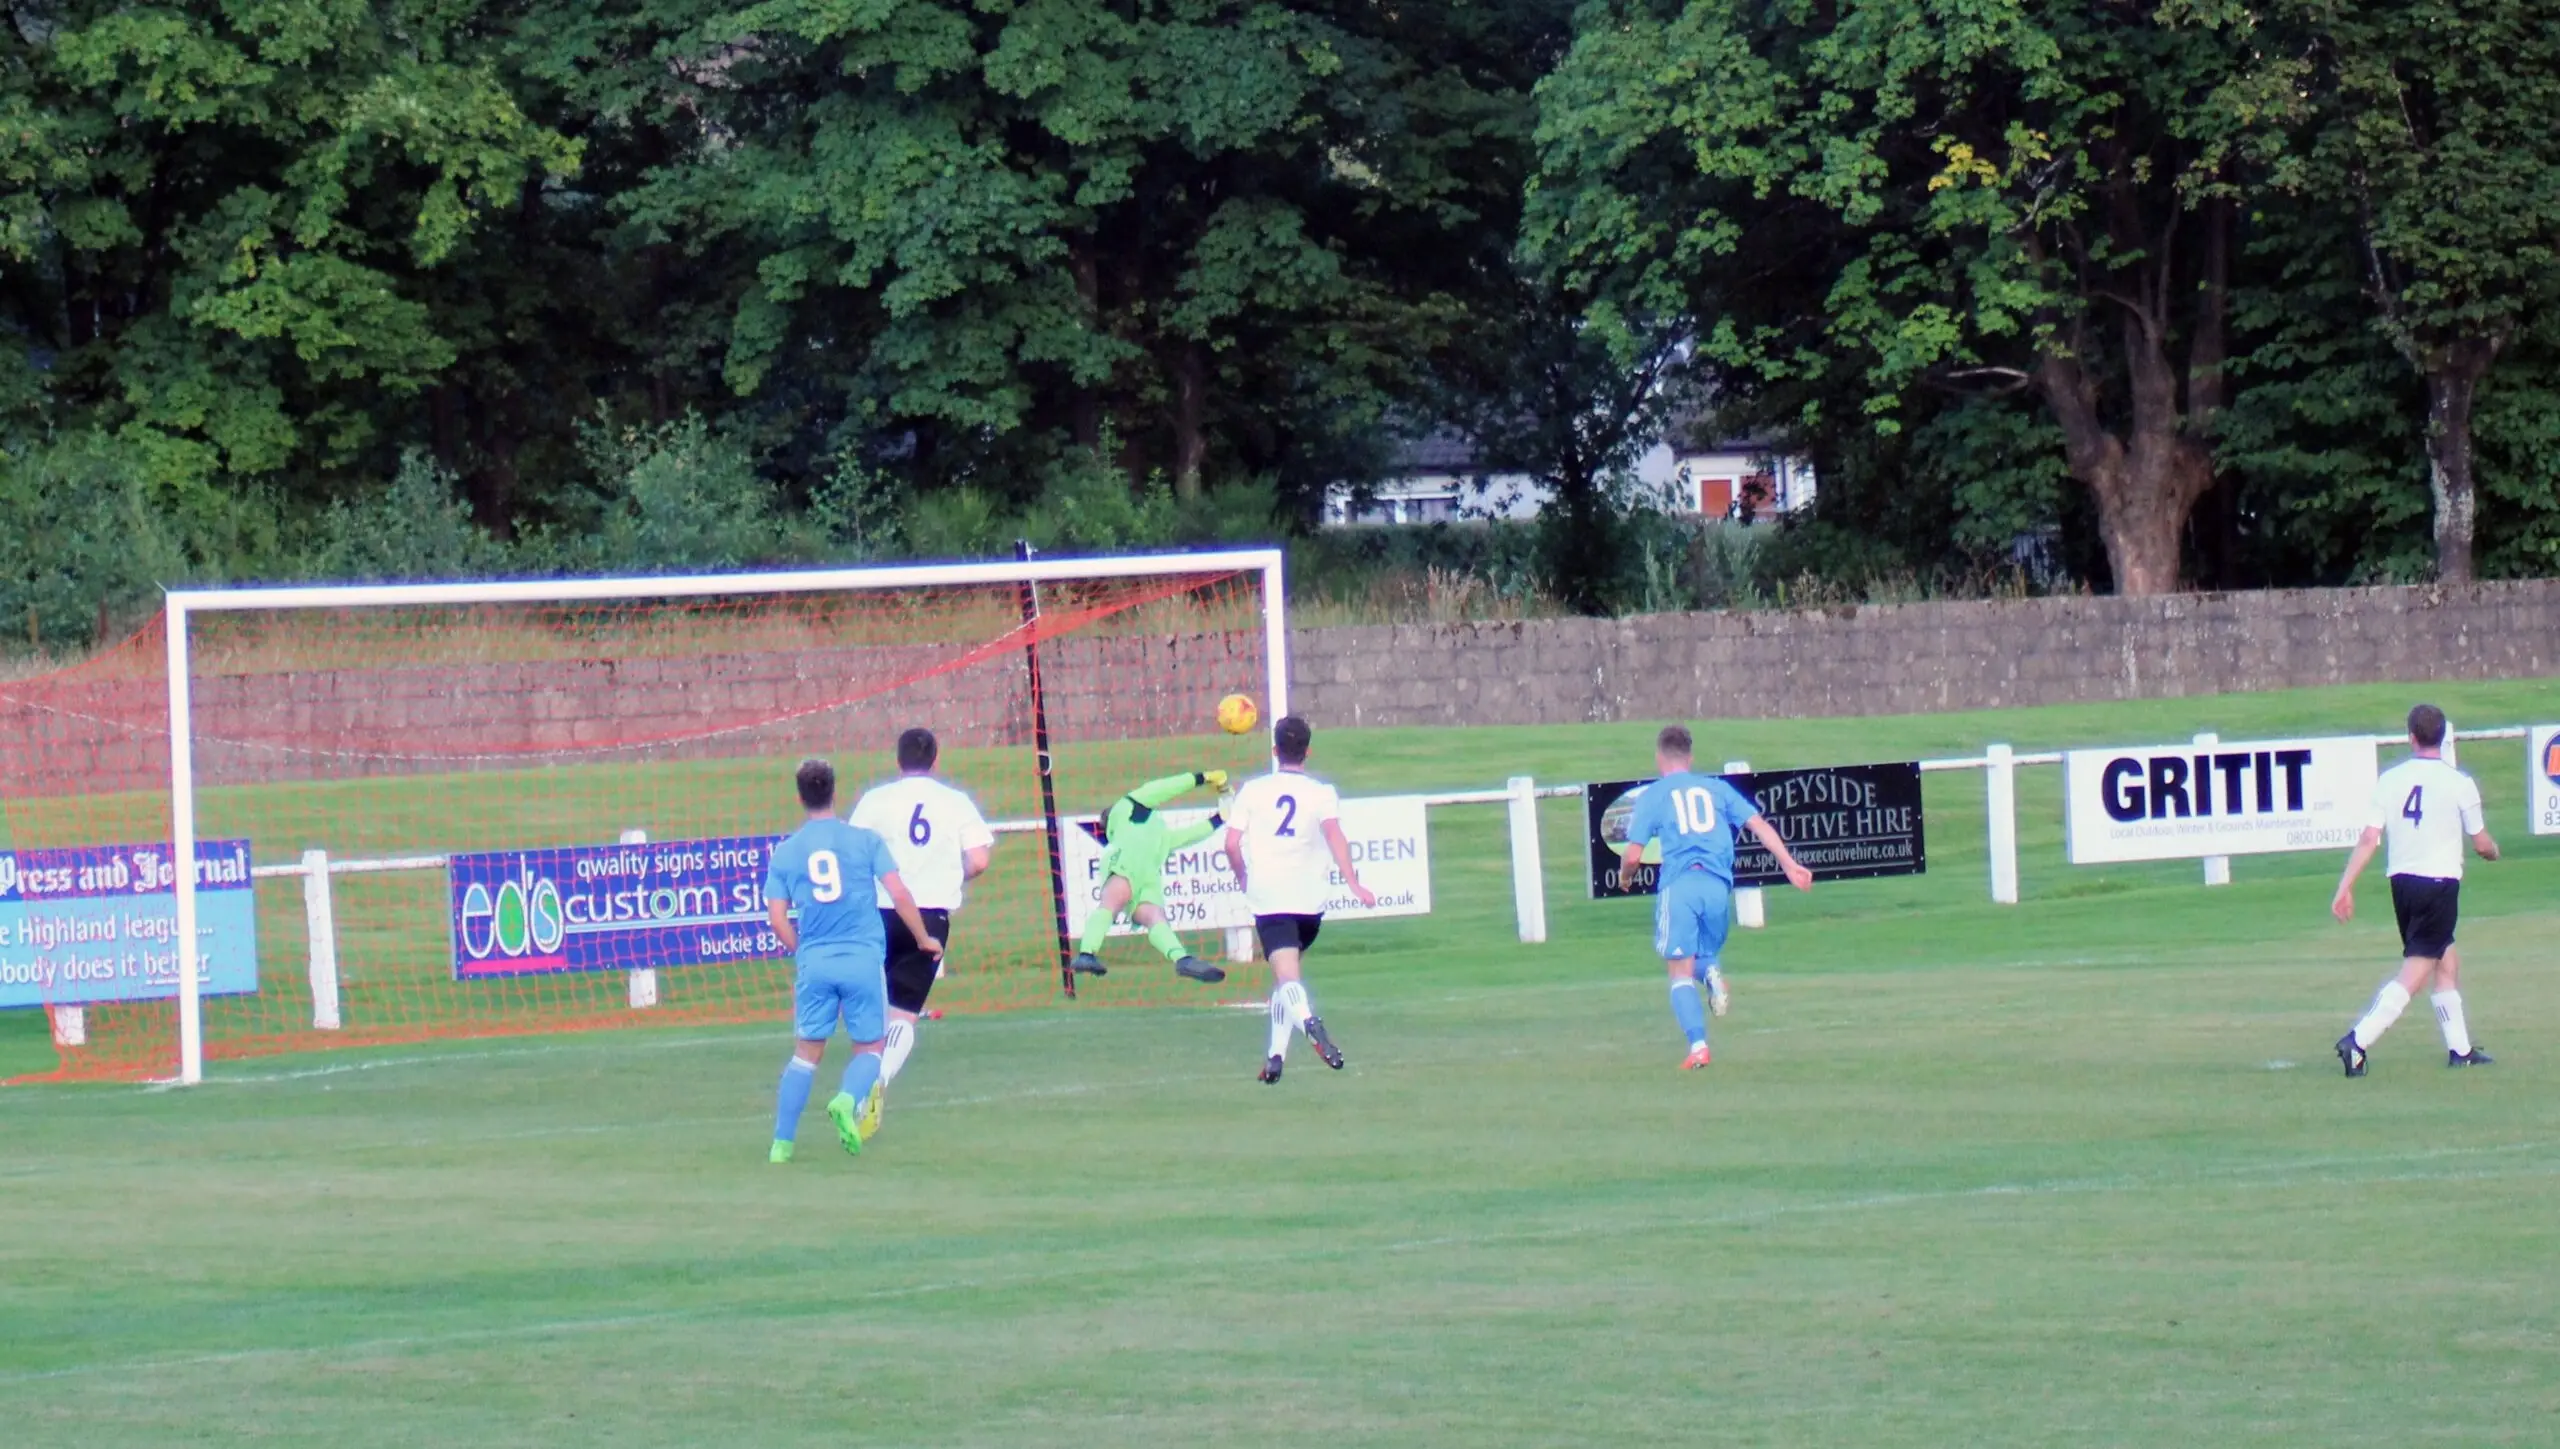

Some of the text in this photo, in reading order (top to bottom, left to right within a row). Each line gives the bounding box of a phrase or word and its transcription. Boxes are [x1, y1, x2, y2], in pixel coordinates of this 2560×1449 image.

[1755, 773, 1877, 815] SPEYSIDE
[2102, 749, 2312, 822] GRITIT
[2403, 785, 2423, 828] 4
[909, 803, 931, 847] 6
[1274, 794, 1296, 837] 2
[1671, 787, 1715, 834] 10
[1856, 806, 1912, 835] HIRE
[79, 855, 129, 890] and
[133, 847, 247, 892] Jornal
[654, 848, 704, 878] signs
[710, 843, 759, 869] since
[808, 850, 841, 903] 9
[564, 884, 718, 923] custom
[18, 913, 116, 950] Highland
[701, 931, 752, 955] buckie
[64, 954, 114, 981] does
[121, 952, 137, 977] it
